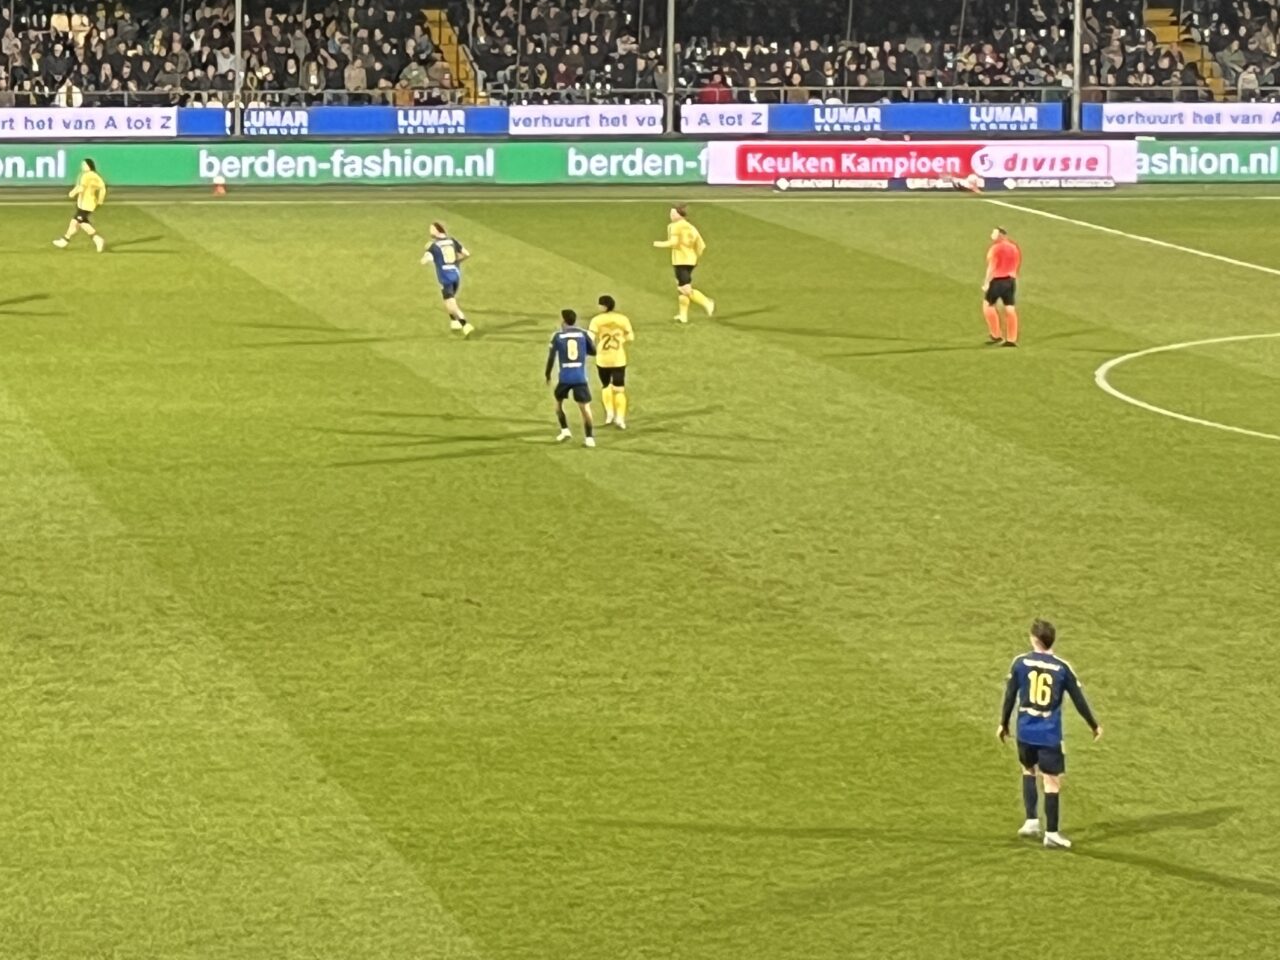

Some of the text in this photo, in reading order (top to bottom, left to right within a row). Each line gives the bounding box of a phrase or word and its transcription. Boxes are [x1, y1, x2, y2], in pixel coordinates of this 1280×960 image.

[397, 109, 465, 126] LUMAR
[512, 113, 590, 127] verhuurt
[599, 114, 627, 127] het
[698, 113, 710, 126] A
[719, 113, 742, 126] tot
[751, 112, 762, 126] Z
[814, 107, 881, 123] LUMAR
[969, 106, 1038, 122] LUMAR
[1106, 110, 1184, 125] verhuurt
[1192, 111, 1221, 125] het
[1230, 113, 1263, 125] van
[24, 115, 54, 130] het
[62, 118, 95, 130] van
[104, 116, 117, 129] A
[126, 115, 152, 129] tot
[161, 115, 172, 129] Z
[199, 147, 494, 178] berden-fashion.nl
[746, 149, 1099, 179] Keuken Kampioen divisie
[1028, 670, 1053, 706] 16
